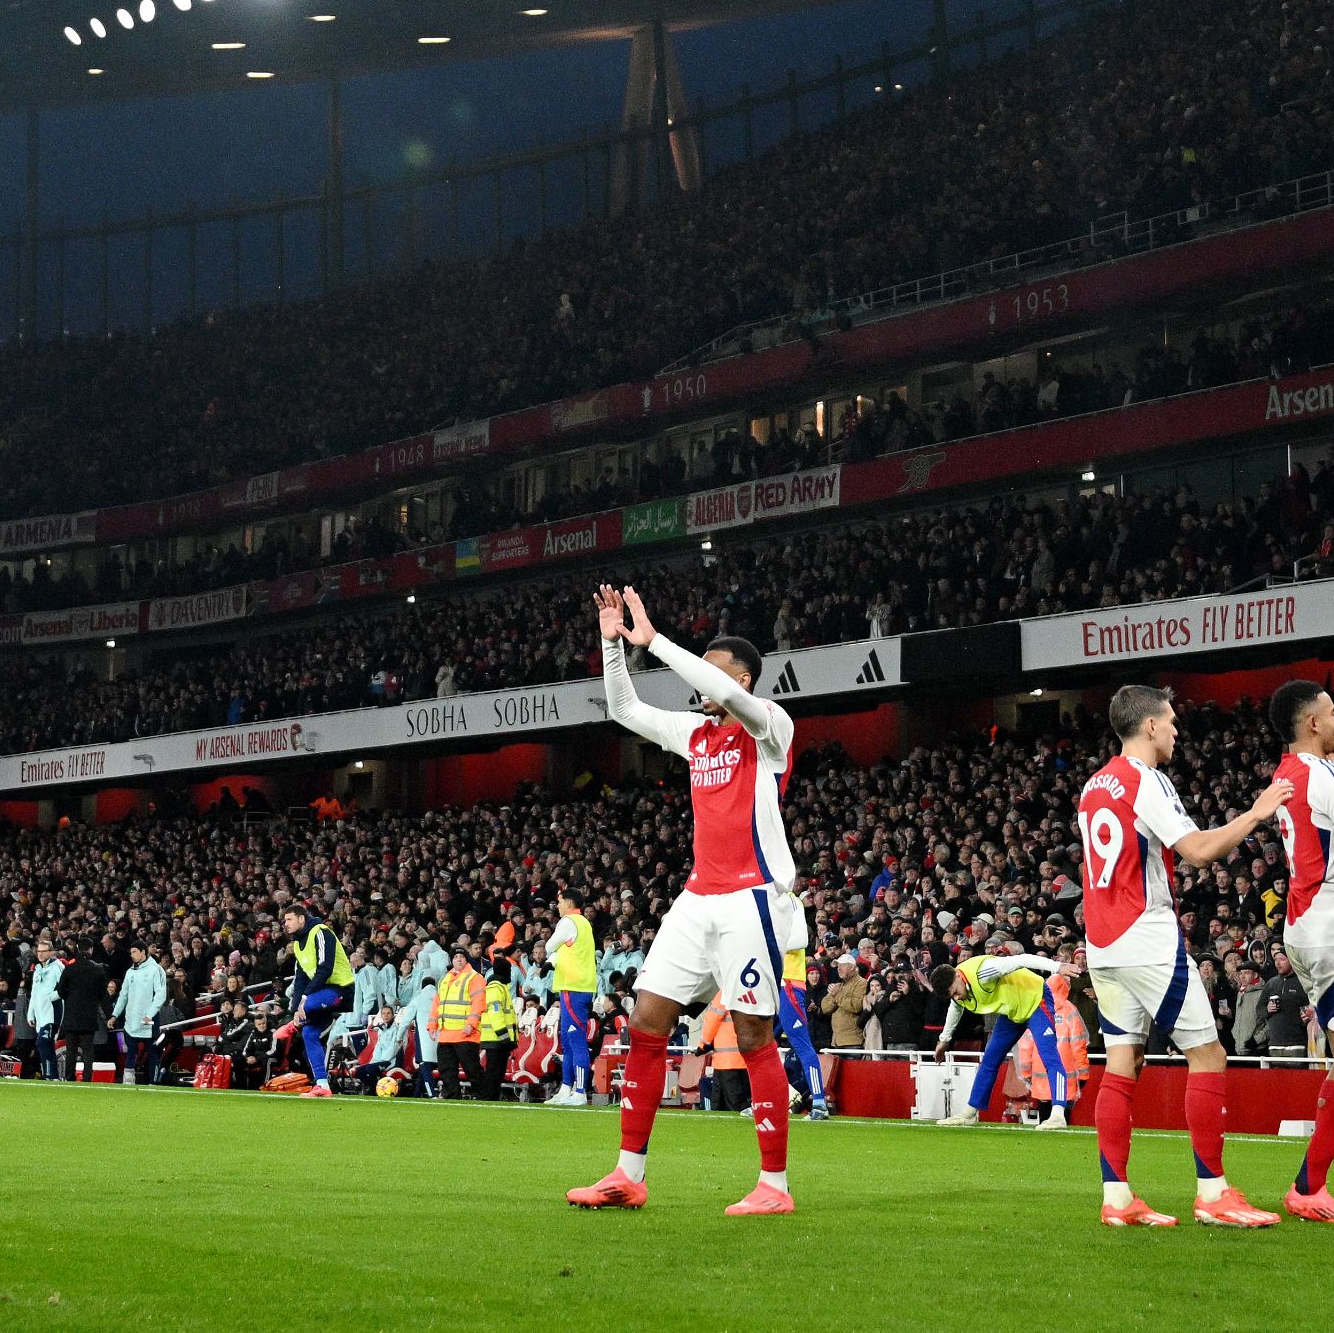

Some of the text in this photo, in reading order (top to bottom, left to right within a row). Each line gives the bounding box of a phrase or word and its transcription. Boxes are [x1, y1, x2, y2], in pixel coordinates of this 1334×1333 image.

[1012, 284, 1069, 320] 1953
[662, 374, 706, 404] 1950
[389, 443, 424, 472] 1948
[696, 473, 837, 526] ALGERIA RED ARMY
[3, 516, 74, 548] ARMENIA
[544, 521, 597, 557] Arsenal
[170, 589, 232, 625] DAVENTRY
[24, 608, 138, 639] Arsenal Liberia
[1082, 596, 1296, 656] Emirates FLY BETTER
[407, 692, 560, 737] SOBHA SOBHA
[196, 727, 288, 760] MY ARSENAL REWARDS
[21, 751, 106, 783] Emirates FLY BETTER
[703, 767, 732, 787] BETTER
[1081, 773, 1126, 802] OSSARD
[1078, 807, 1124, 890] 19
[740, 957, 761, 989] 6
[620, 1080, 638, 1088] FC
